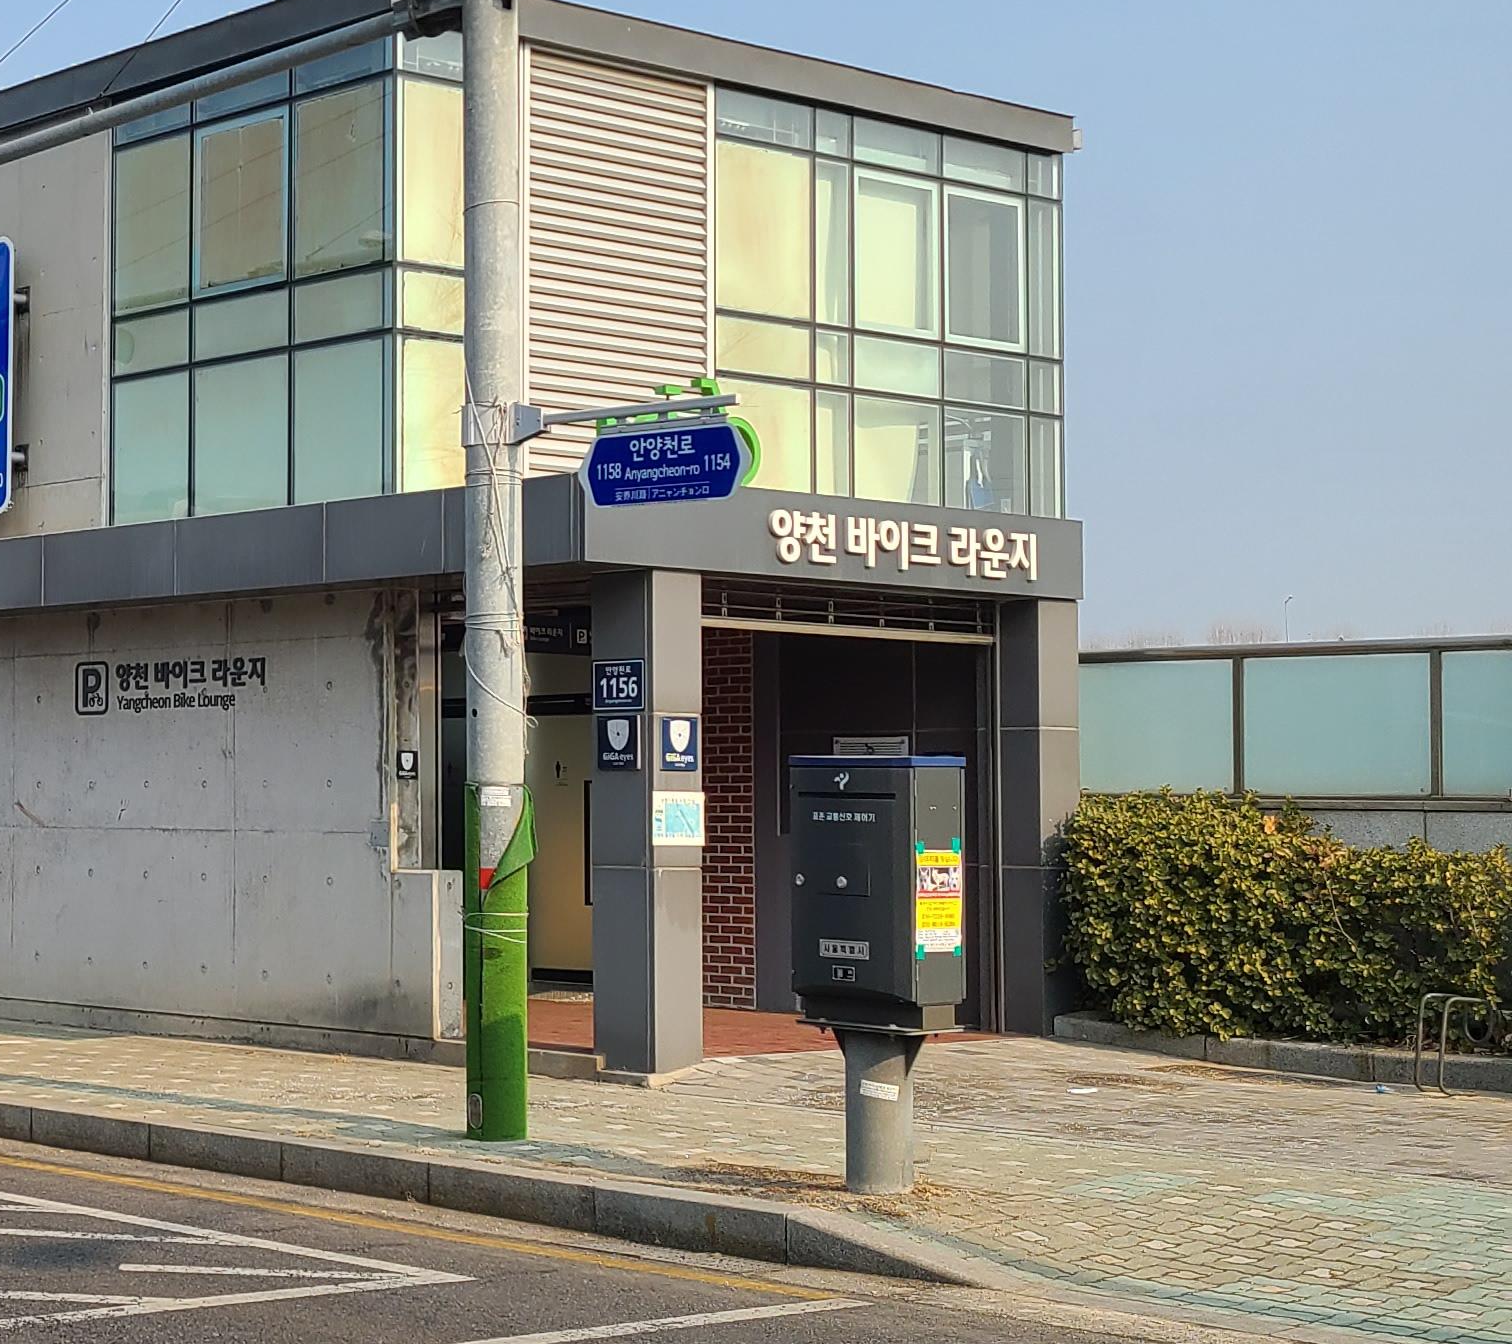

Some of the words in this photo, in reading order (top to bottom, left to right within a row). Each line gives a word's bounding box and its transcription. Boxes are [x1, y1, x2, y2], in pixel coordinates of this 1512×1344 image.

[629, 435, 696, 461] 안양천로
[596, 463, 622, 480] 1158
[624, 464, 700, 482] Anyangcheon-ro
[704, 453, 731, 472] 1154
[768, 508, 837, 564] 양천
[845, 515, 942, 571] 바이크
[948, 526, 1038, 582] 라운지
[115, 663, 149, 692] 양천
[154, 659, 207, 689] 바이크
[211, 656, 266, 688] 라운지
[600, 677, 637, 698] 1156
[116, 691, 172, 713] Yangcheon
[173, 692, 195, 708] Bike
[197, 692, 236, 711] Lounge
